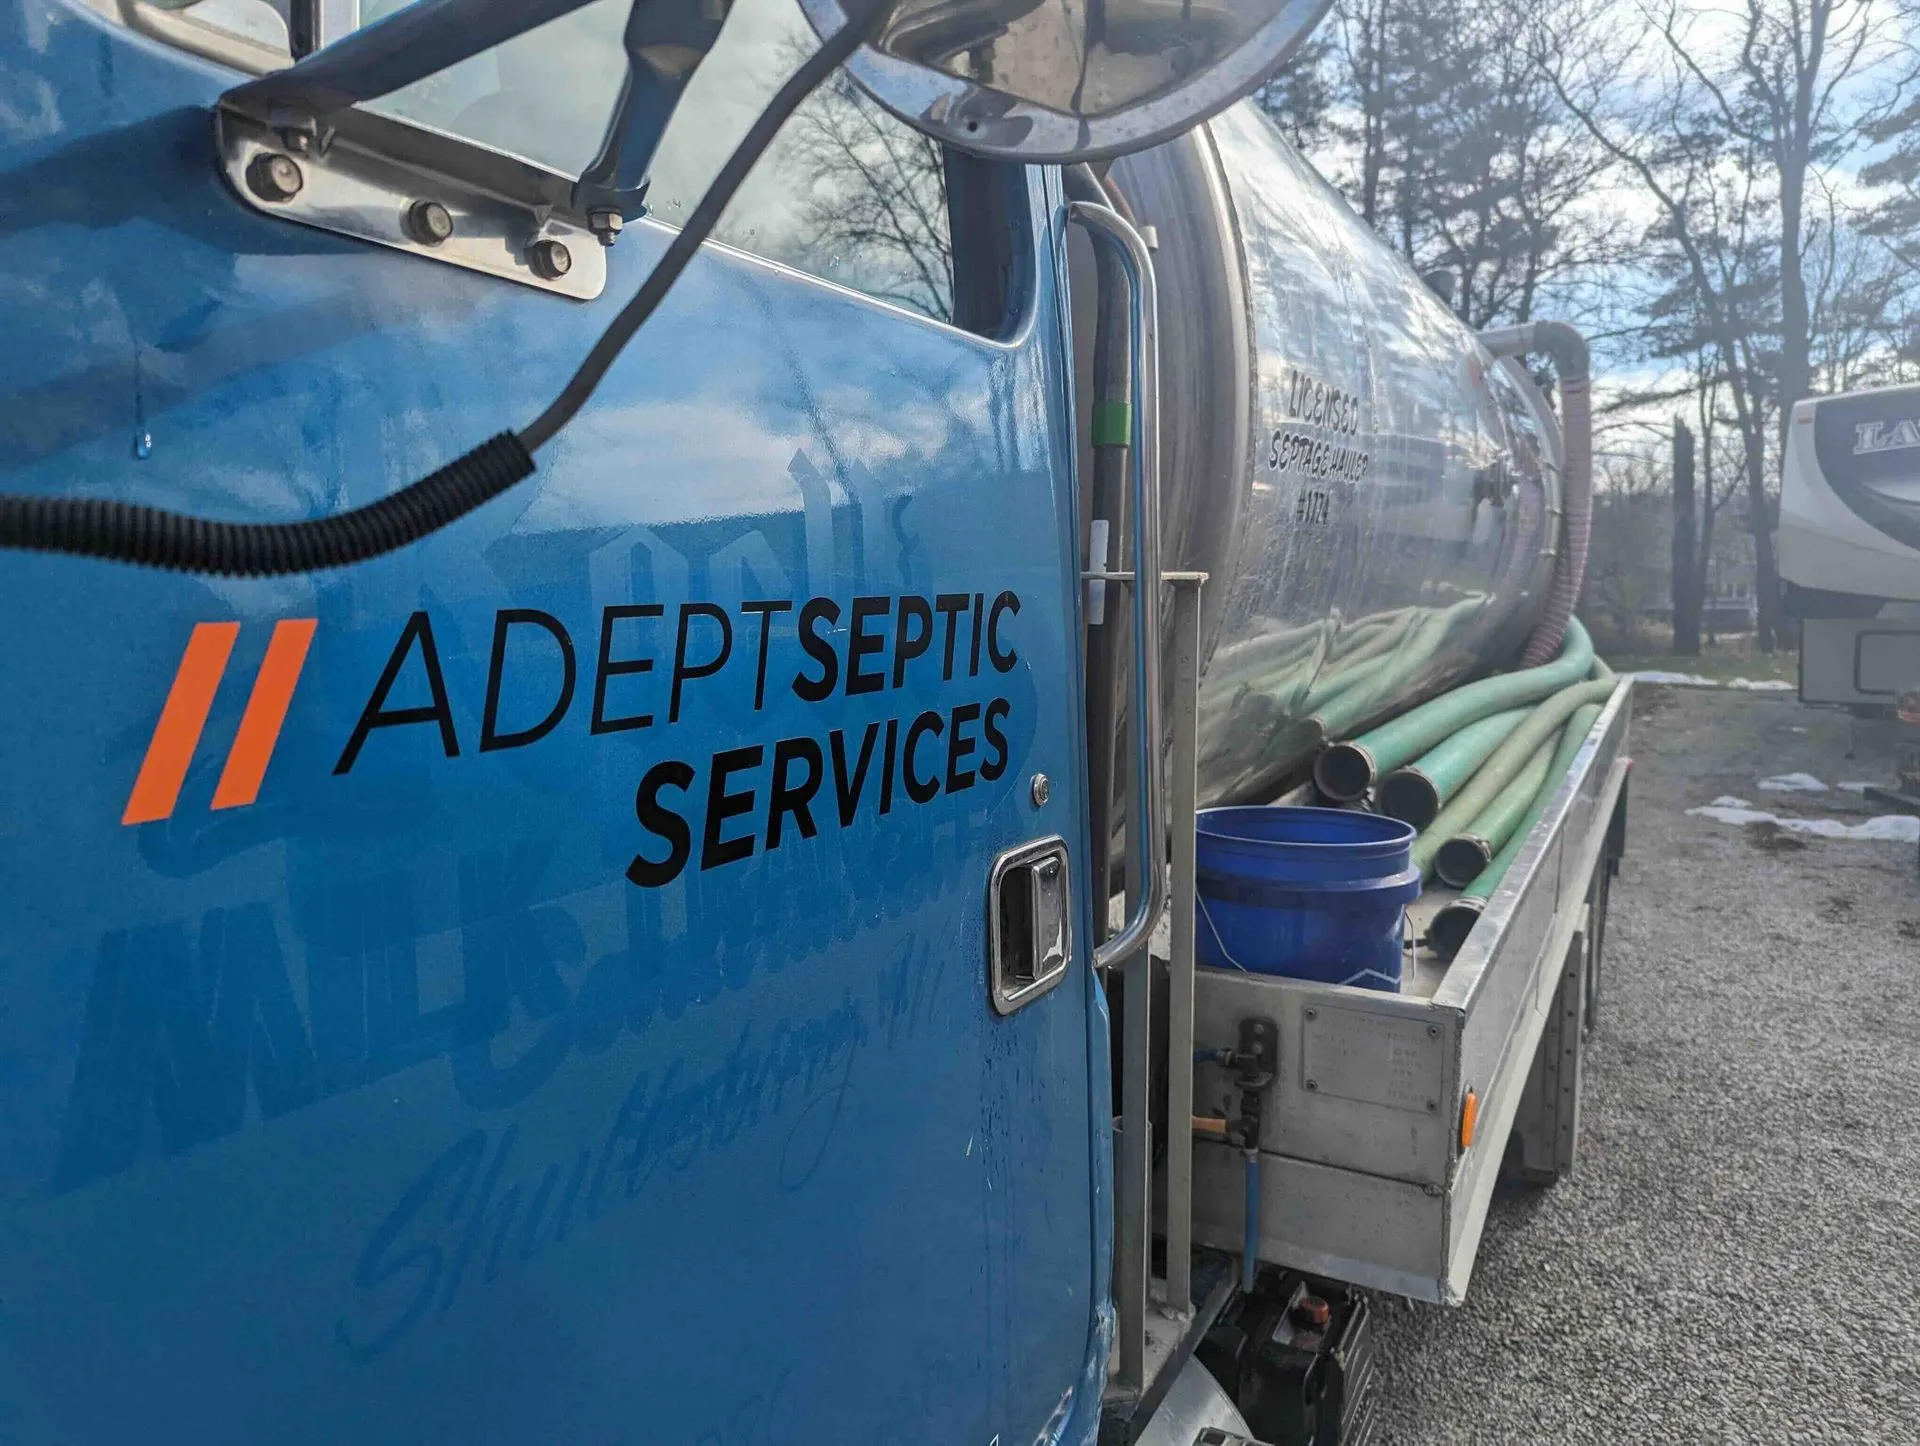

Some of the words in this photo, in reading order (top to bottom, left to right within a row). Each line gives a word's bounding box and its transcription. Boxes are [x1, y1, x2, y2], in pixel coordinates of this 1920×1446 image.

[1290, 371, 1358, 435] LICENSED
[1269, 430, 1331, 477] SEPTAGE
[1854, 419, 1920, 455] LA
[625, 697, 1011, 888] SERVICES
